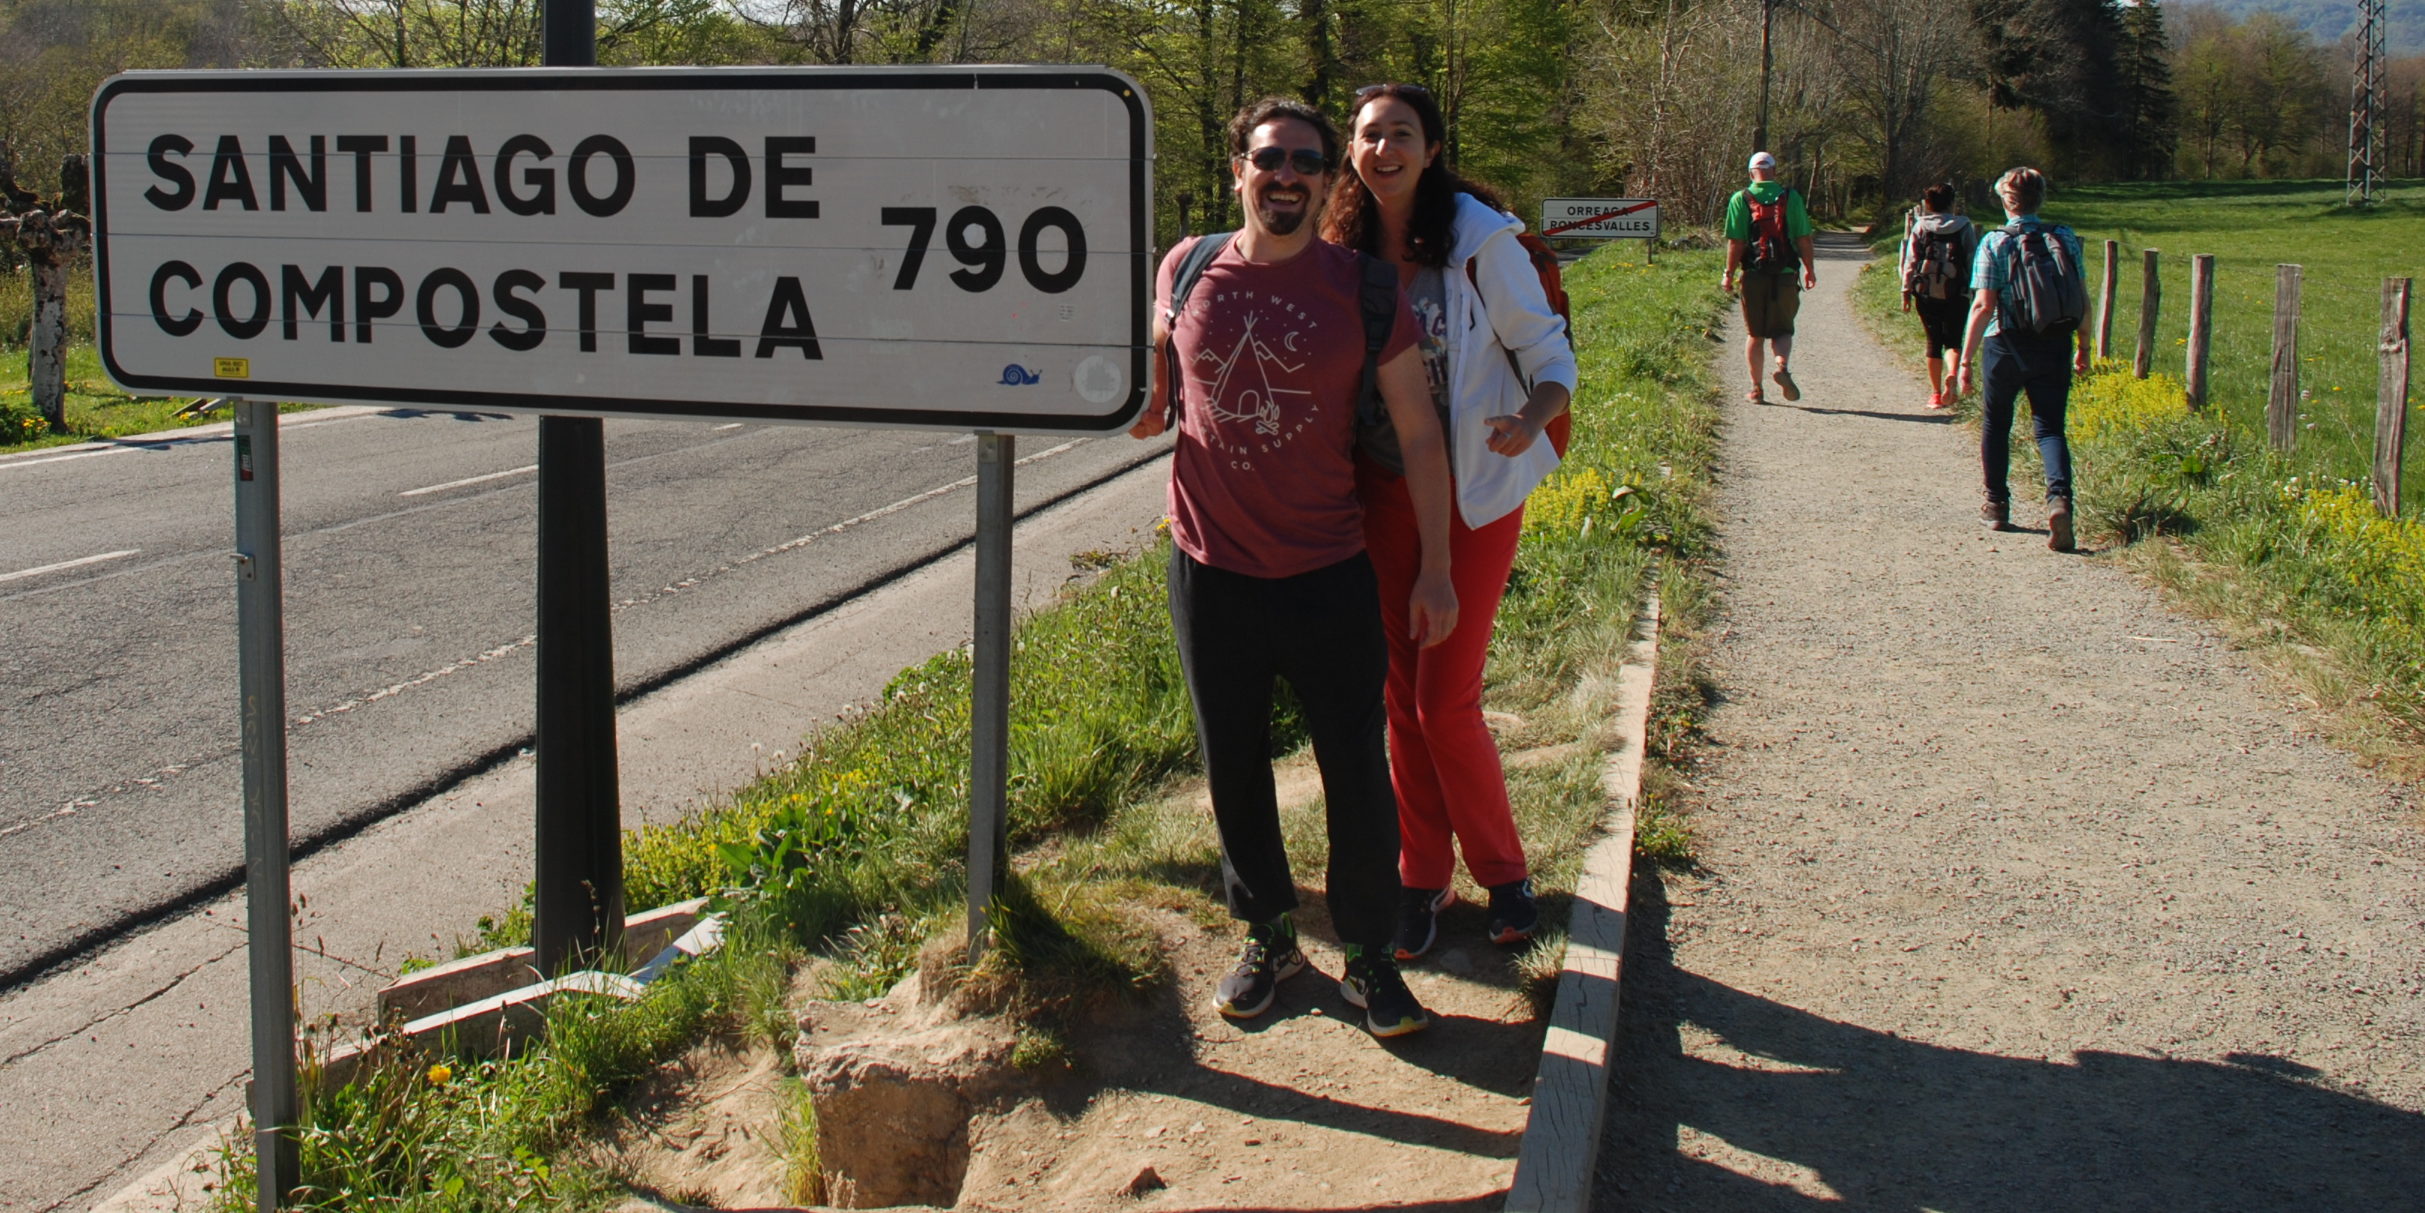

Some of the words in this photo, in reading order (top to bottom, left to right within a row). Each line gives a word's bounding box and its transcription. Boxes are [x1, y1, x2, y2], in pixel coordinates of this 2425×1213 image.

[144, 133, 636, 218] SANTIAGO
[688, 136, 820, 219] DE
[881, 205, 1088, 294] 790
[1550, 220, 1650, 232] RONCESVALLES
[149, 259, 824, 361] COMPOSTELA
[1271, 295, 1318, 329] WEST
[1261, 404, 1320, 454] SUPPLY
[1231, 460, 1255, 471] CO.
